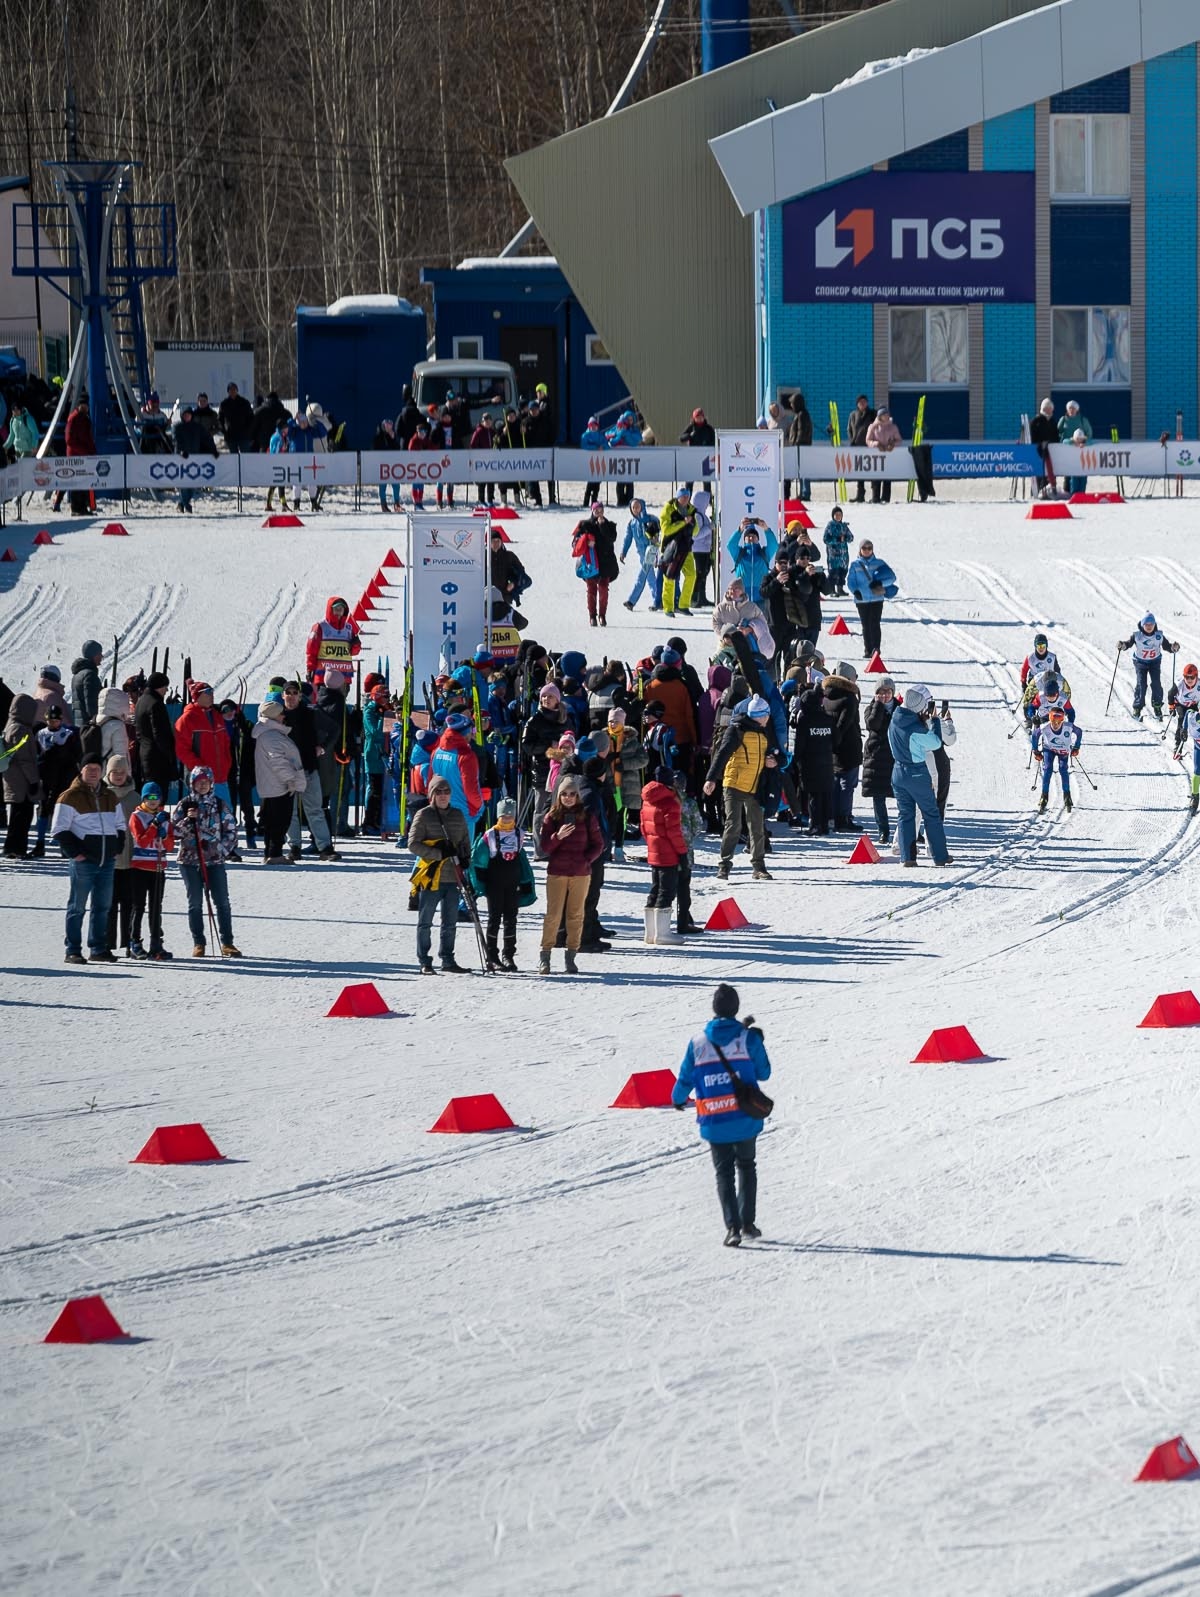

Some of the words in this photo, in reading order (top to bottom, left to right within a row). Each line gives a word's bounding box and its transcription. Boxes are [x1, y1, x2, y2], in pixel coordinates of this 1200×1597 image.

[891, 217, 1005, 260] ПСБ
[815, 286, 850, 296] СПОНСОР
[851, 286, 898, 297] ФЕДЕРАЦИИ
[899, 286, 935, 297] ЛЫЖНЫХ
[937, 287, 961, 296] ГОНОК
[962, 286, 1005, 297] УДМУРТИИ
[167, 342, 241, 351] ИНФОРМАЦИЯ
[951, 451, 1014, 462] ТЕХНОПАРК
[1099, 451, 1131, 468] ИЗТТ
[474, 458, 547, 471] РУСКЛИМАТ
[608, 457, 641, 475] ИЗТТ
[854, 455, 886, 472] ИЗТТ
[932, 462, 993, 473] РУСКЛИМАТ
[150, 461, 216, 480] СОЮЗ
[379, 463, 442, 480] BOSCO
[1141, 649, 1157, 659] 75
[809, 727, 832, 736] Kappa
